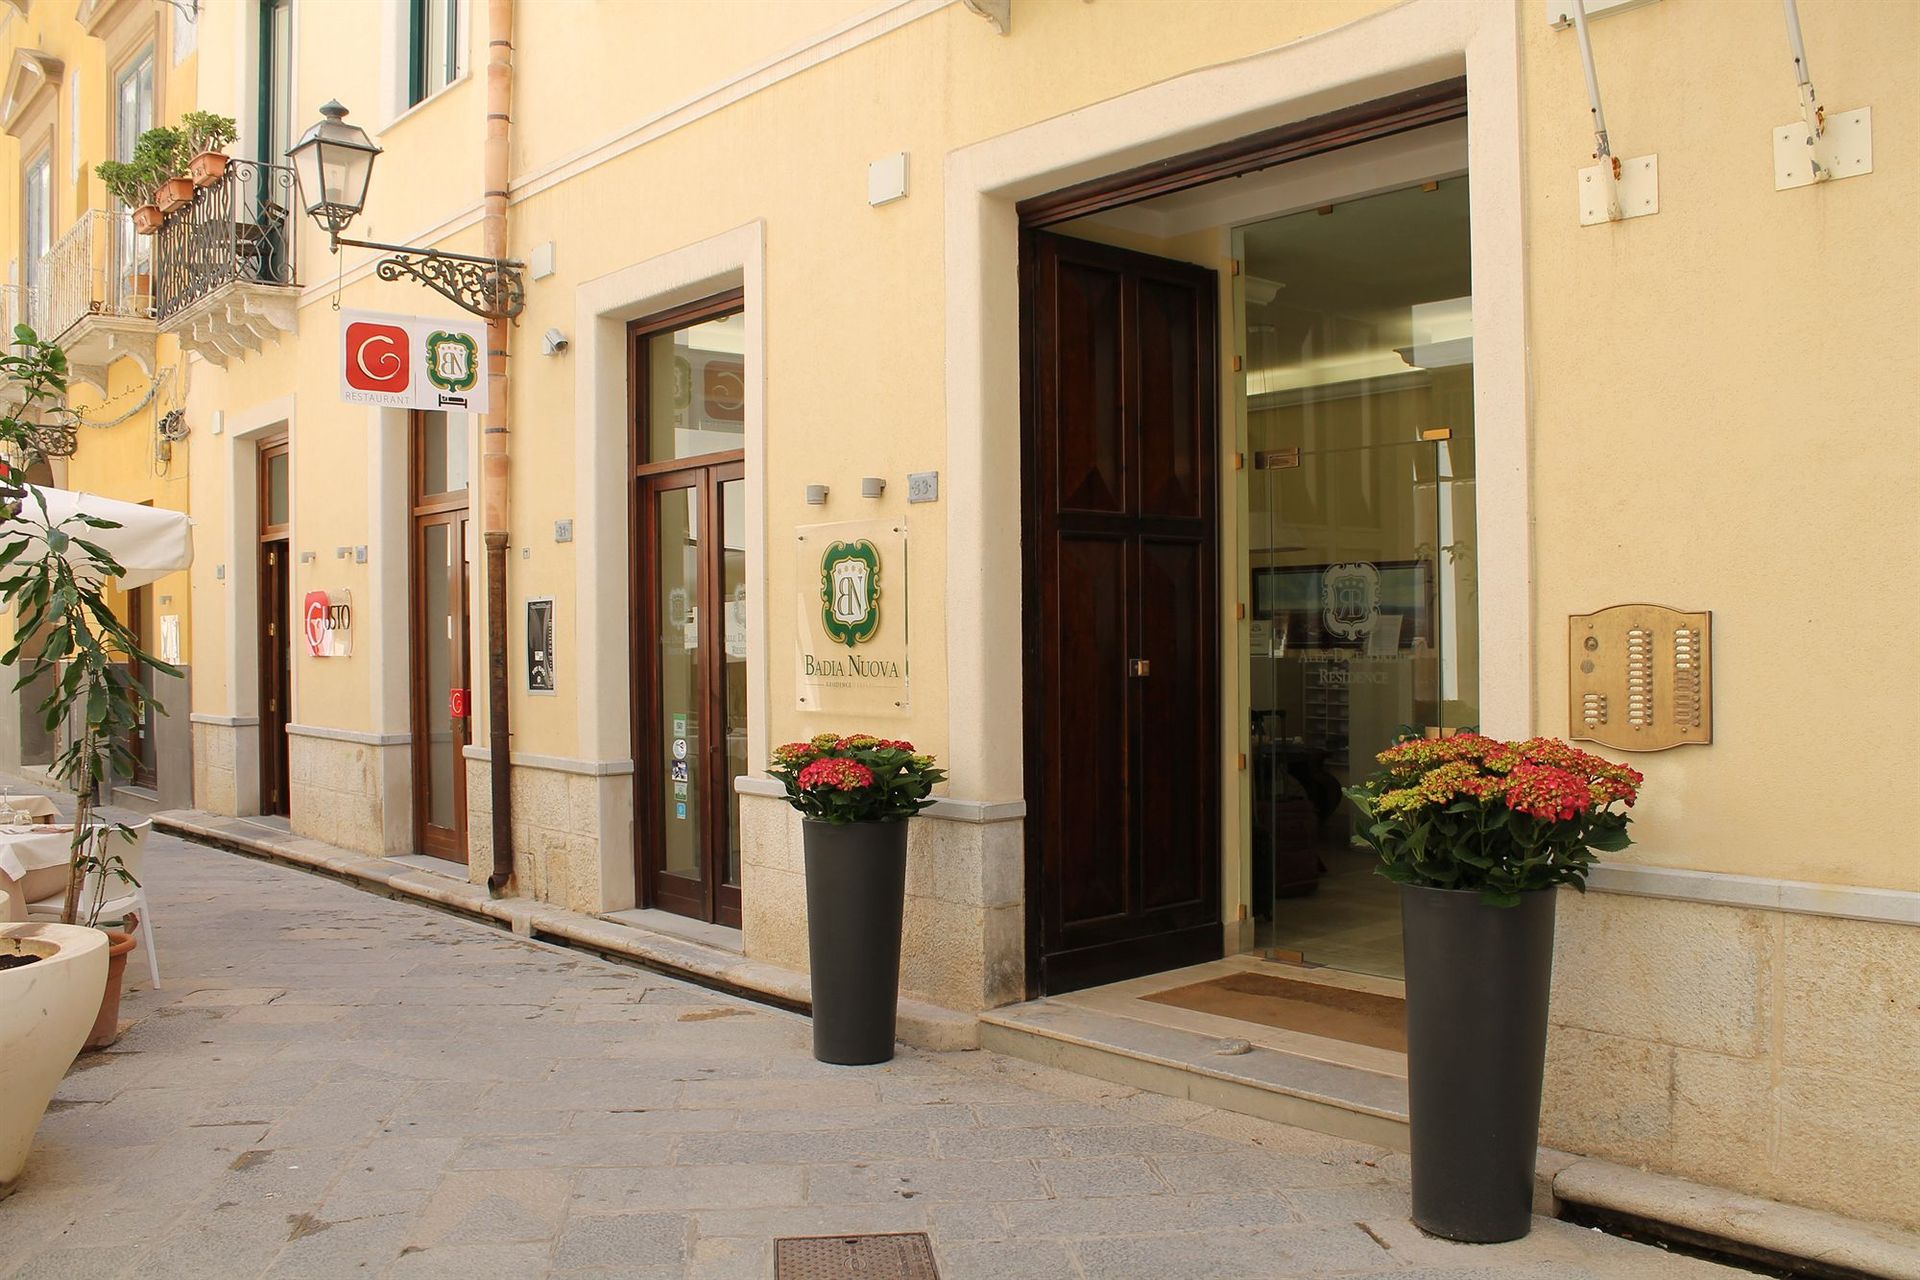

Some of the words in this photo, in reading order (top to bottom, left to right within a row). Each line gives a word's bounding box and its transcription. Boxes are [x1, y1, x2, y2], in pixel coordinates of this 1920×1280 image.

[357, 335, 401, 381] G
[345, 391, 410, 405] RESTAURANT
[804, 654, 845, 676] BADIA
[848, 654, 899, 678] NUOVA
